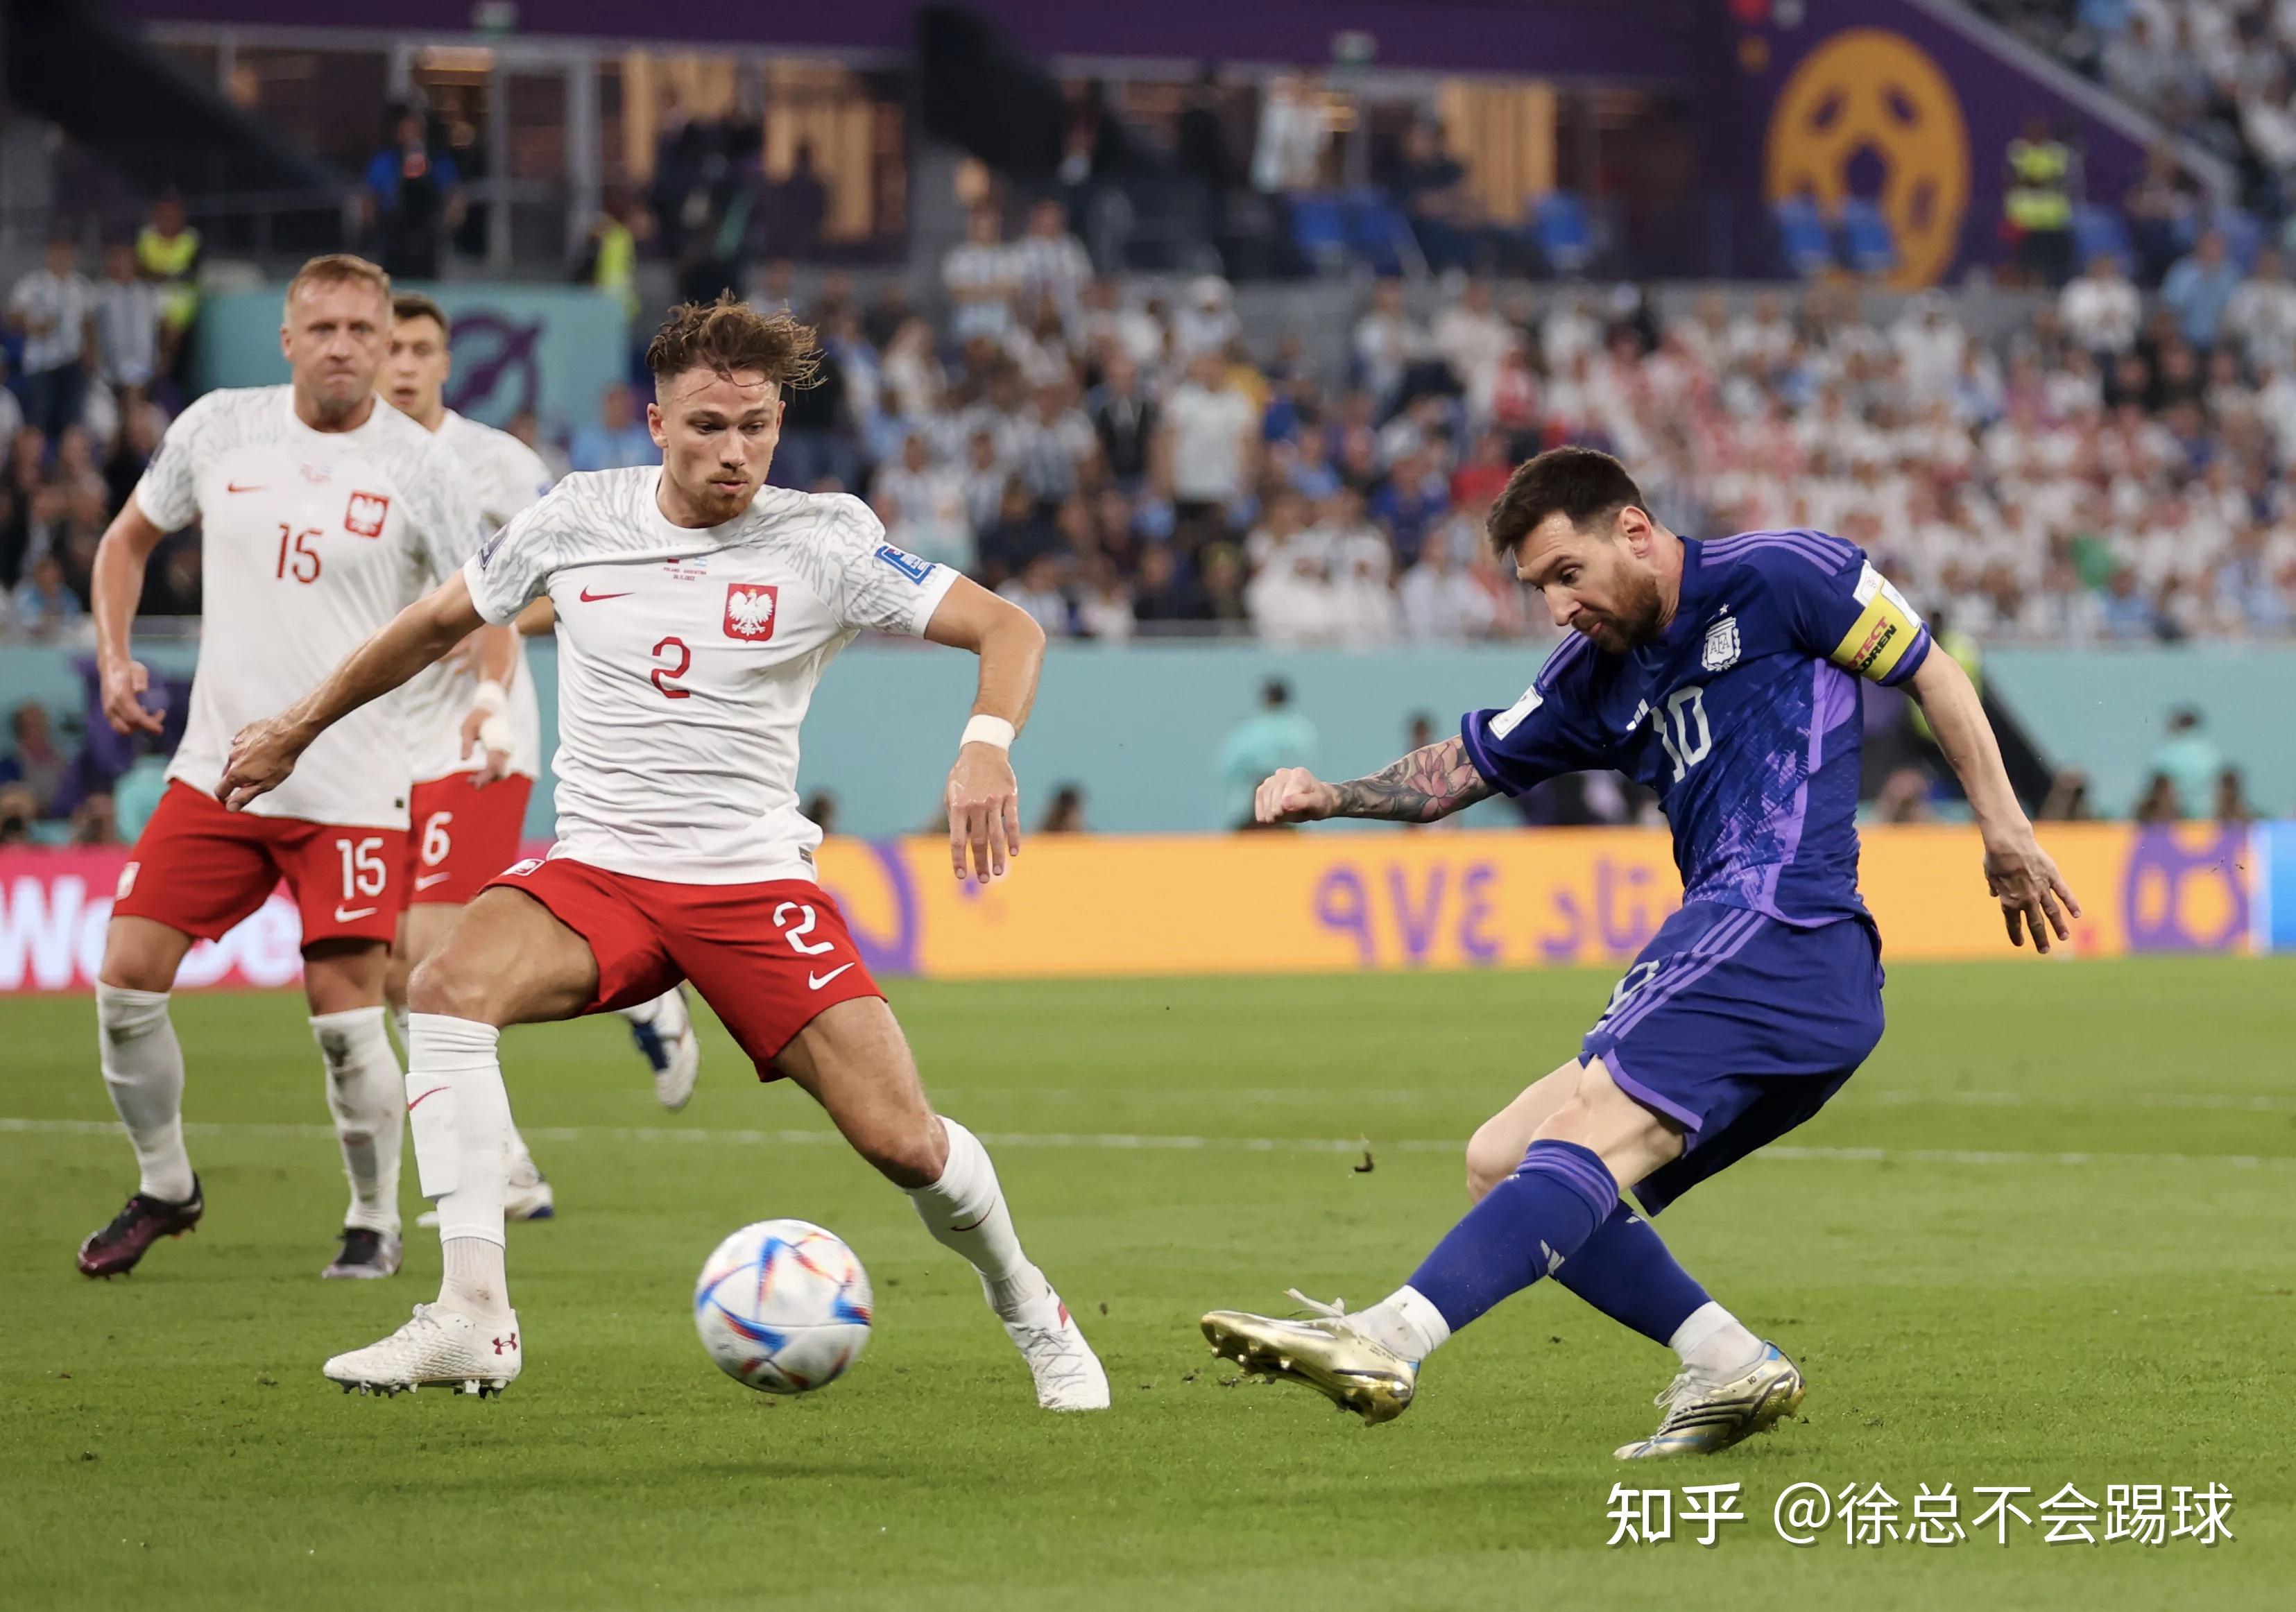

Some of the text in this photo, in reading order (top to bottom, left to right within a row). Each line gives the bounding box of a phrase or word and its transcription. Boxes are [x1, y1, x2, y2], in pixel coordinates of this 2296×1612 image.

[277, 524, 322, 584] 15
[651, 636, 691, 699] 2
[1709, 631, 1731, 655] AFA
[1847, 615, 1887, 671] OTECT
[1649, 685, 1713, 784] 10
[422, 810, 454, 867] 6
[336, 837, 387, 901] 15
[772, 901, 836, 955] 2
